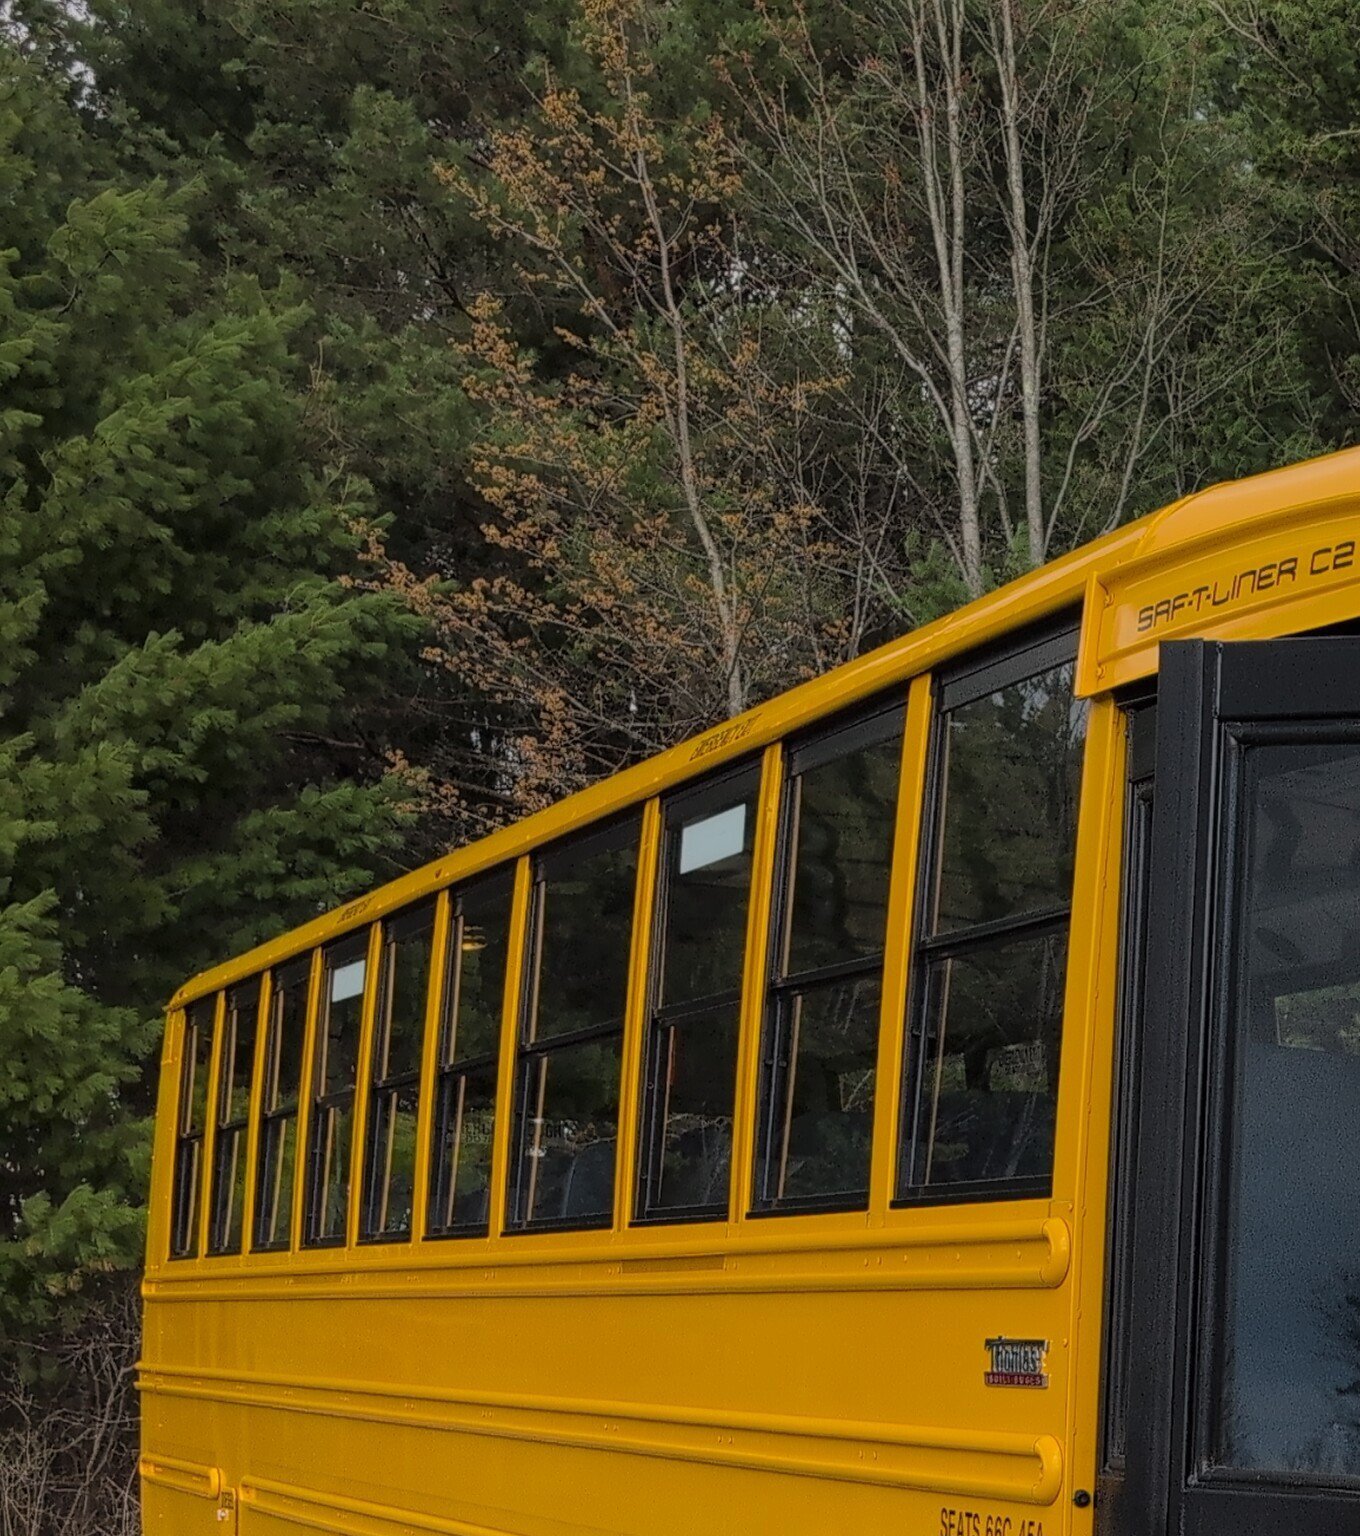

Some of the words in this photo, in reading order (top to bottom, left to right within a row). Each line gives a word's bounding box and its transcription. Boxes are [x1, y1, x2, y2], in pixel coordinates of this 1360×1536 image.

[1136, 557, 1299, 633] SAF-T-LINER
[1309, 541, 1356, 577] C2
[985, 1336, 1049, 1373] Thomas
